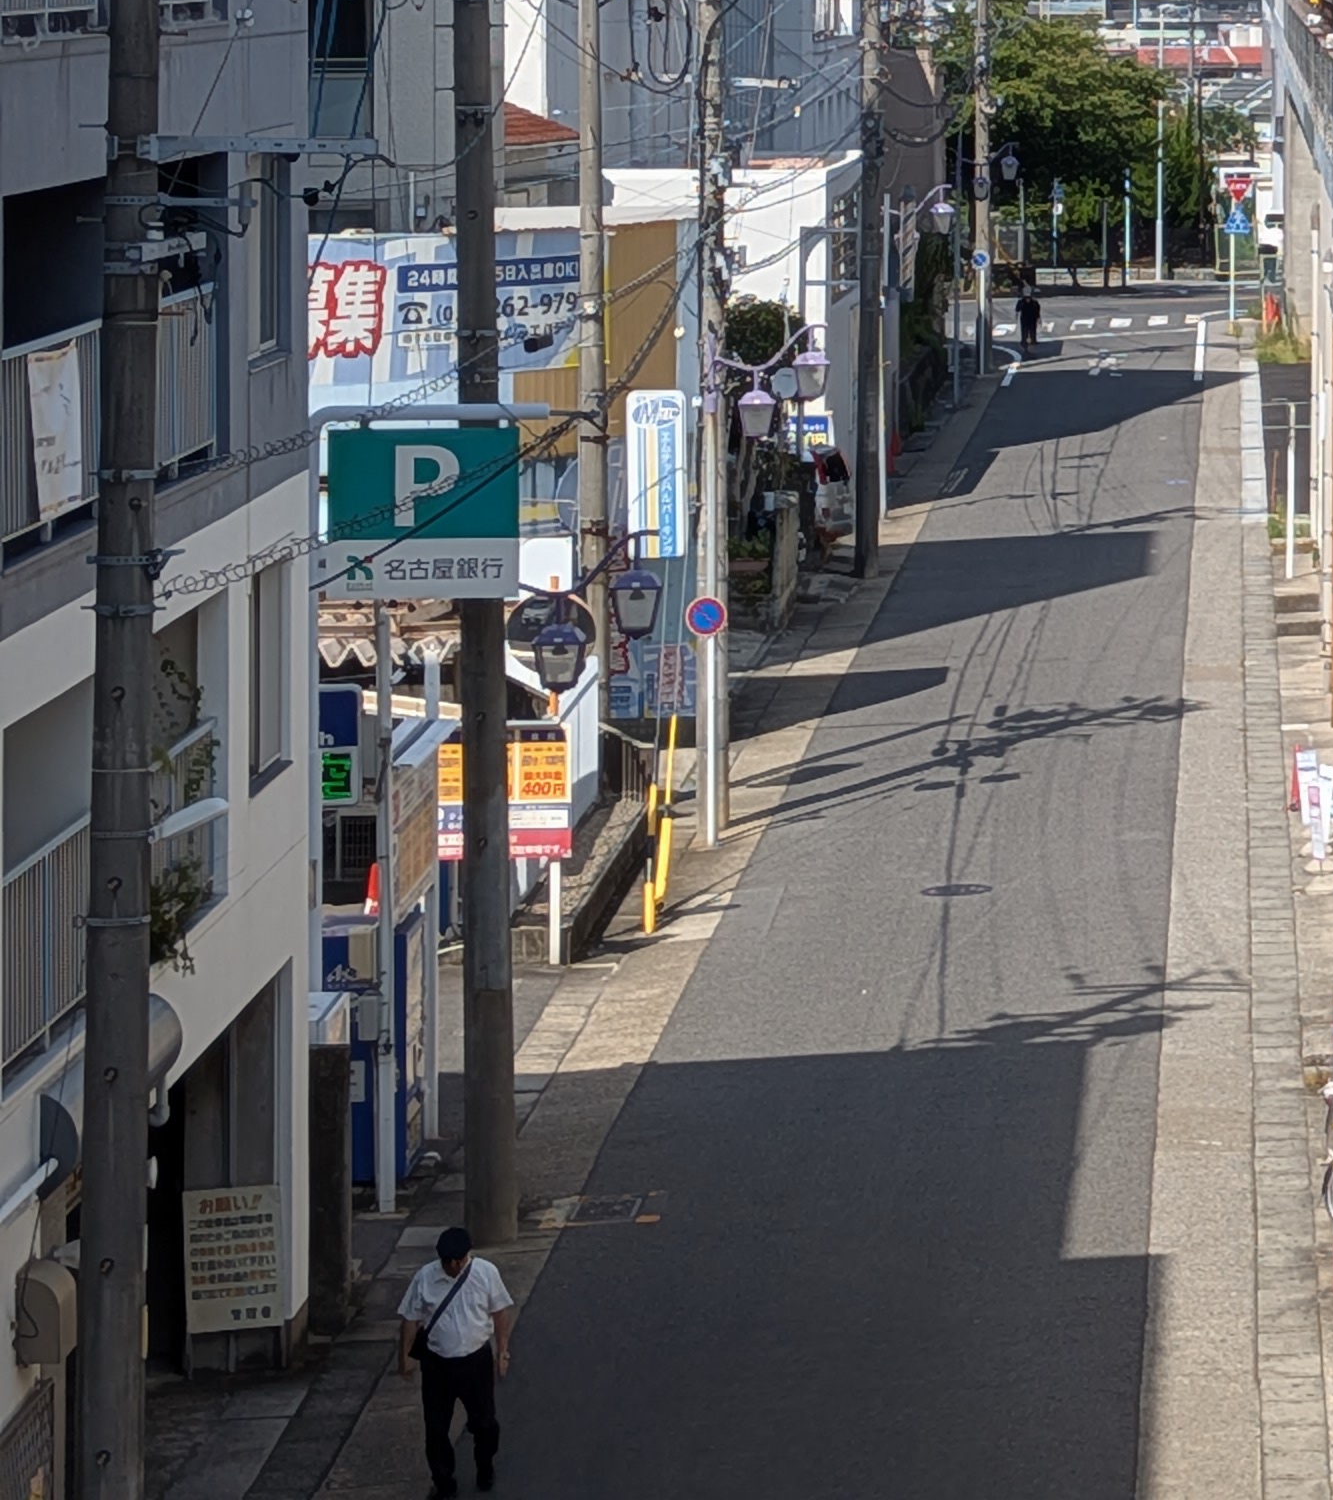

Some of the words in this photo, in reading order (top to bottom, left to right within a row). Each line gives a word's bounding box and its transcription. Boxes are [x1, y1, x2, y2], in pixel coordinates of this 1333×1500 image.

[394, 444, 460, 527] P
[383, 557, 504, 581] 名古屋銀行
[521, 781, 565, 796] 400円
